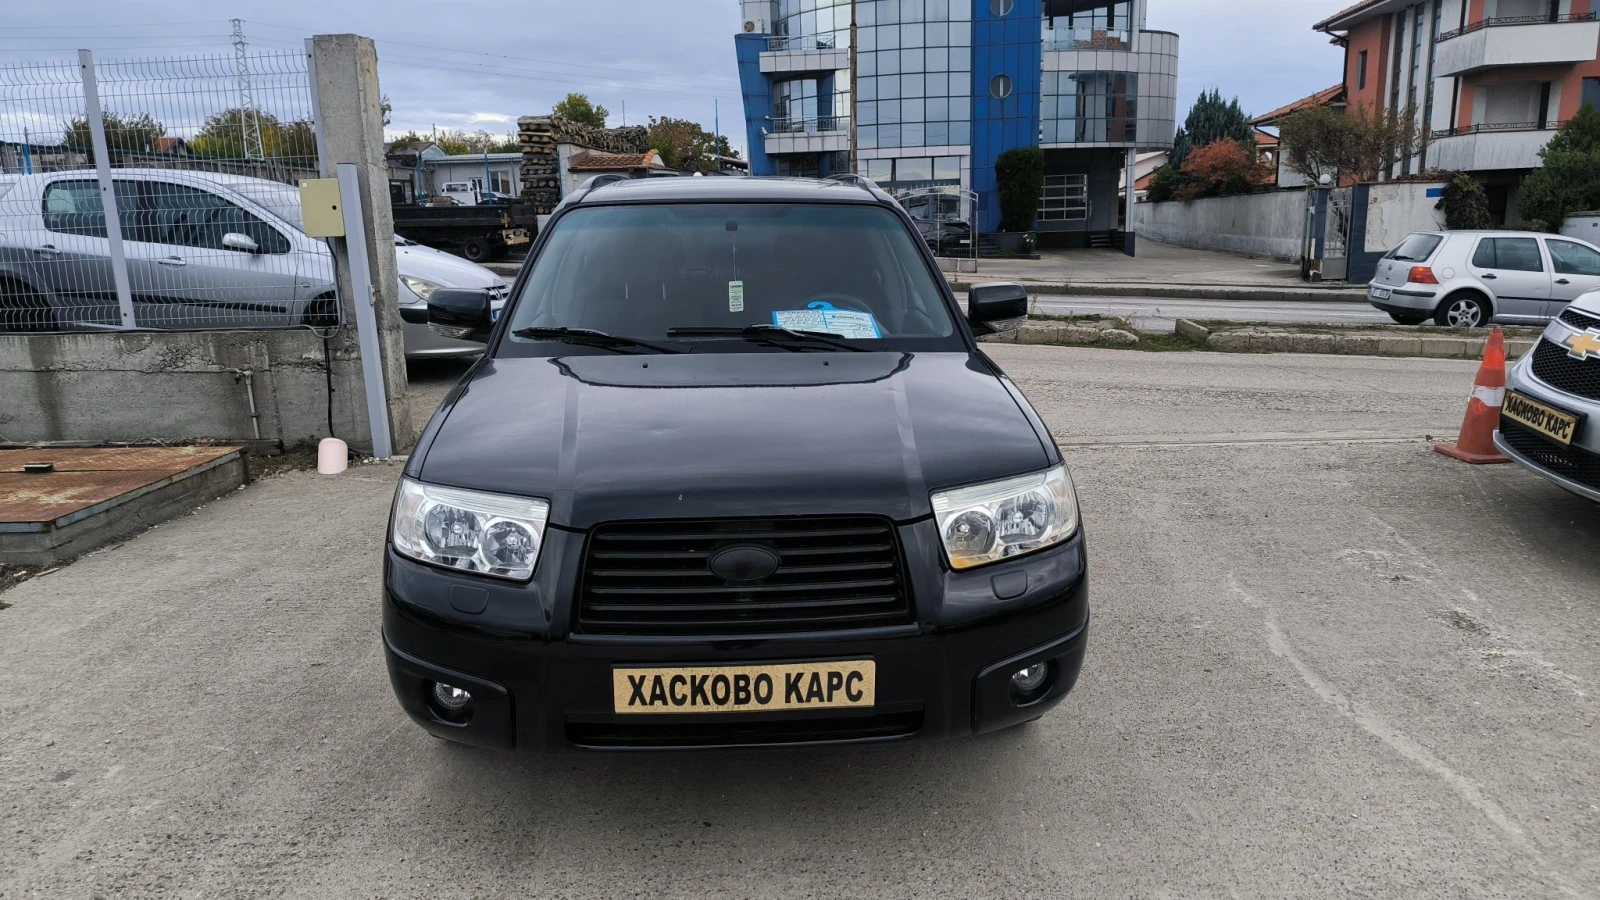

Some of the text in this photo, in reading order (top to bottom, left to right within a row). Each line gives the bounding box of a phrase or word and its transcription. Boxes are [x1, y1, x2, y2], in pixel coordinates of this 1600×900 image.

[1505, 396, 1571, 439] ХАСКОВО КАРС
[627, 671, 864, 706] ХАСКОВО КАРС
